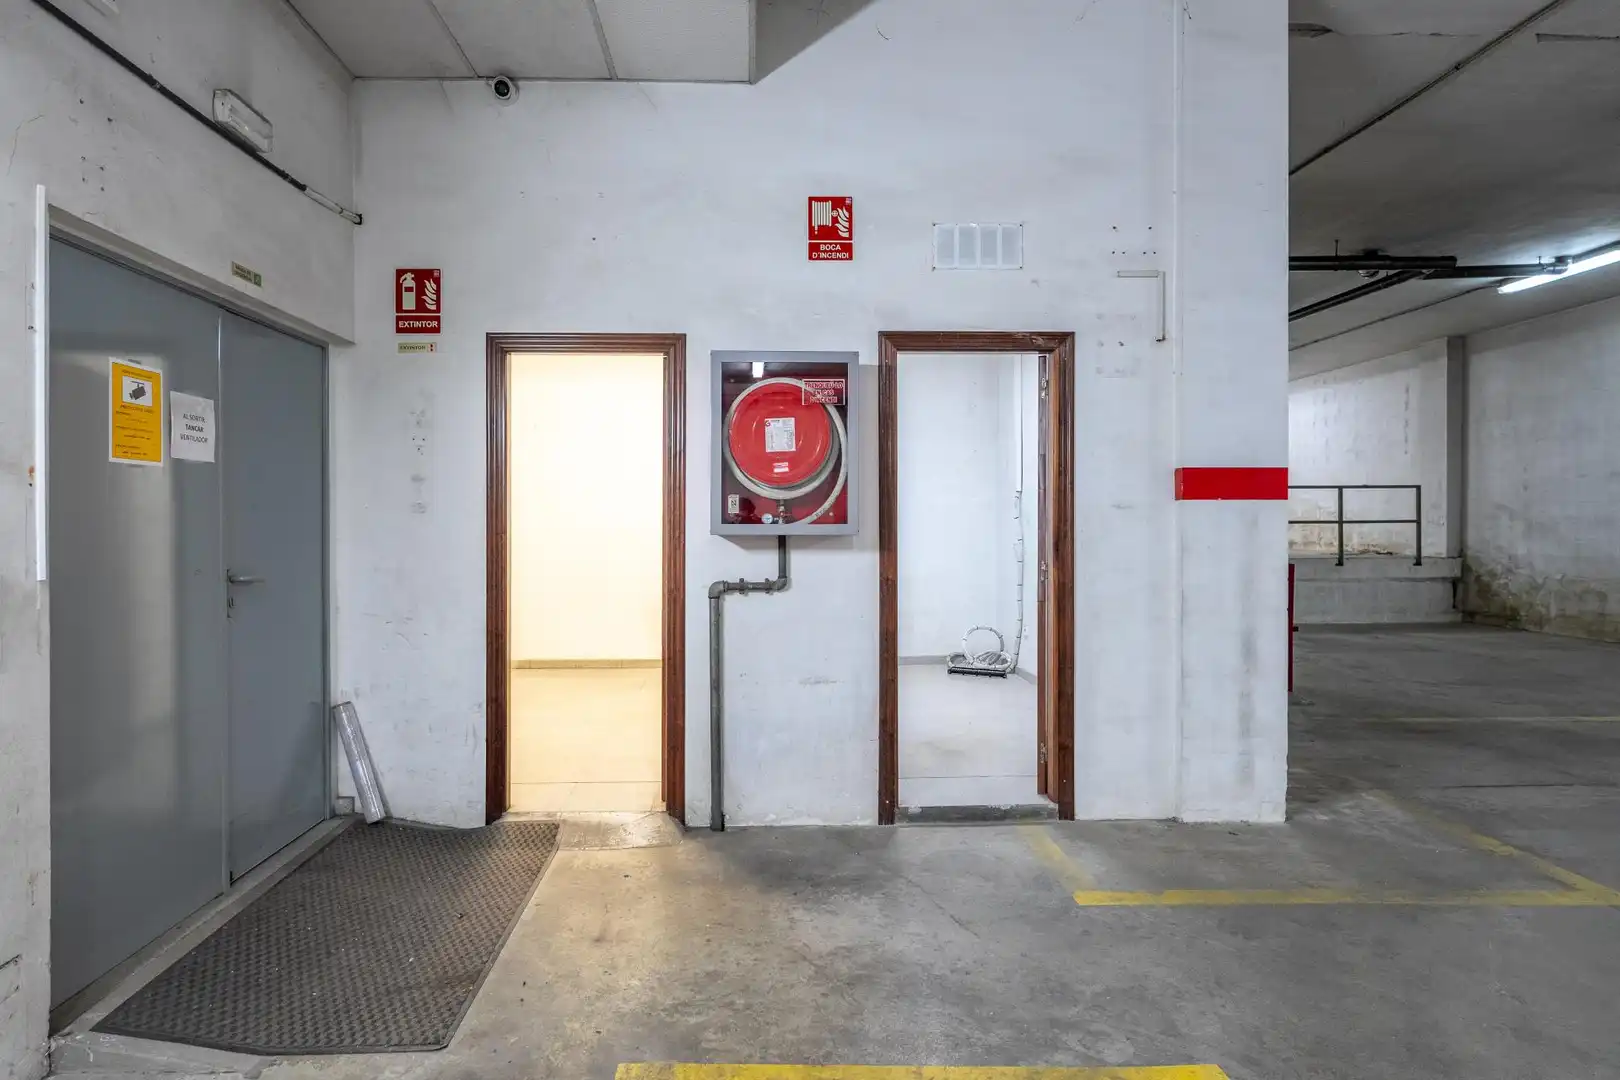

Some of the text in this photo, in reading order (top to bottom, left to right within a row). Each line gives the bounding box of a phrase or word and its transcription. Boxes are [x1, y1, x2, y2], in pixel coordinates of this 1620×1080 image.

[398, 320, 438, 328] EXTINTOR
[185, 423, 204, 432] TANCAR
[180, 433, 208, 443] VENTILADOR
